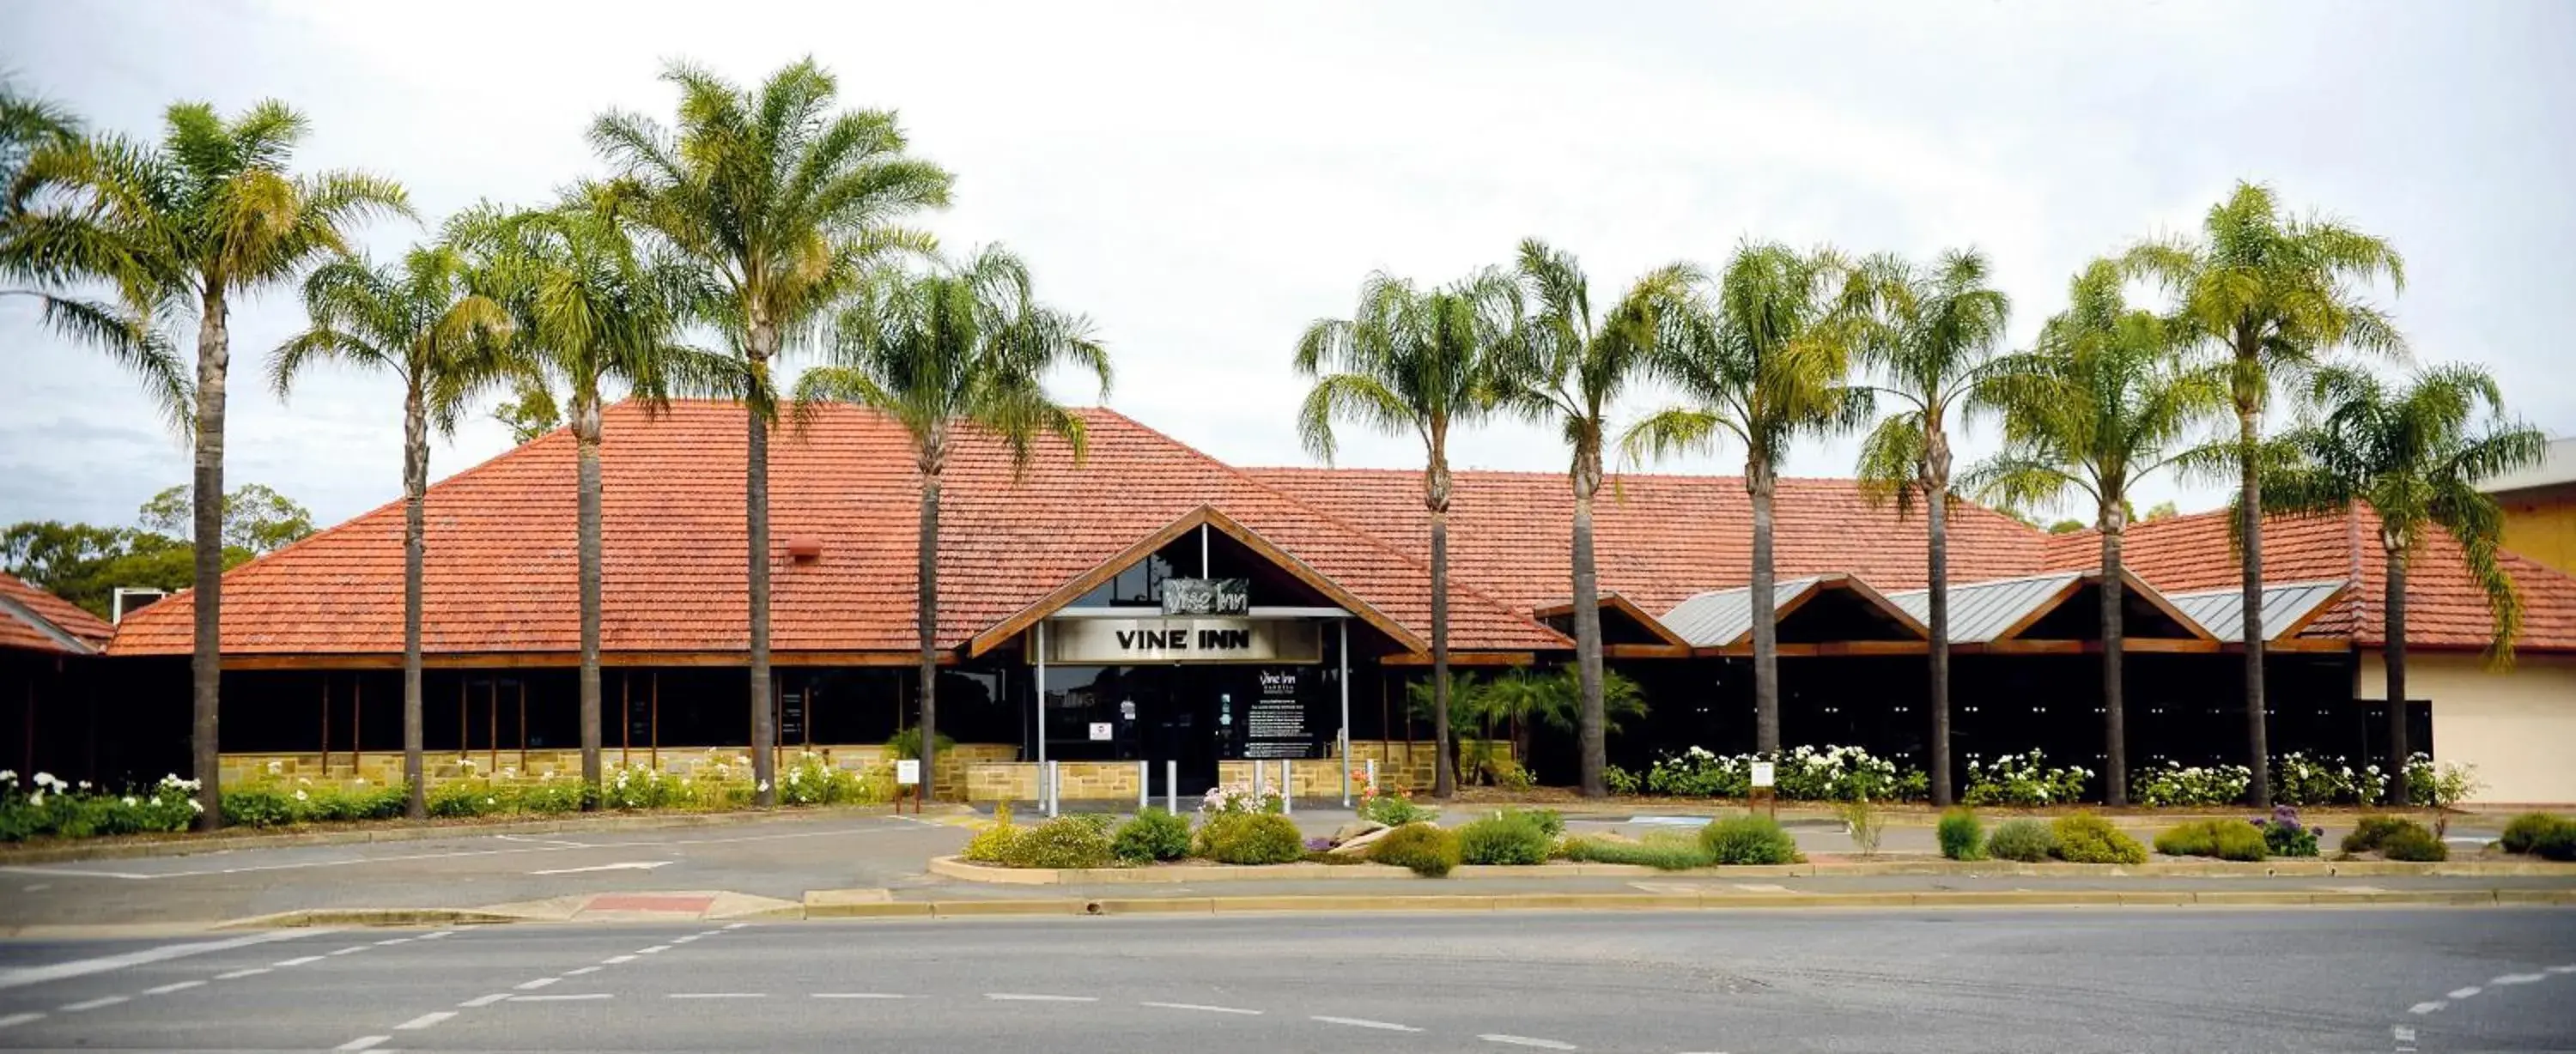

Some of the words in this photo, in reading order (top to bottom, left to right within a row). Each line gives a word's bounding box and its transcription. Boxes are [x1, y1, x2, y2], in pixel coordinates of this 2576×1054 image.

[1217, 584, 1248, 612] Inn
[1116, 630, 1187, 649] VINE
[1199, 630, 1249, 649] INN
